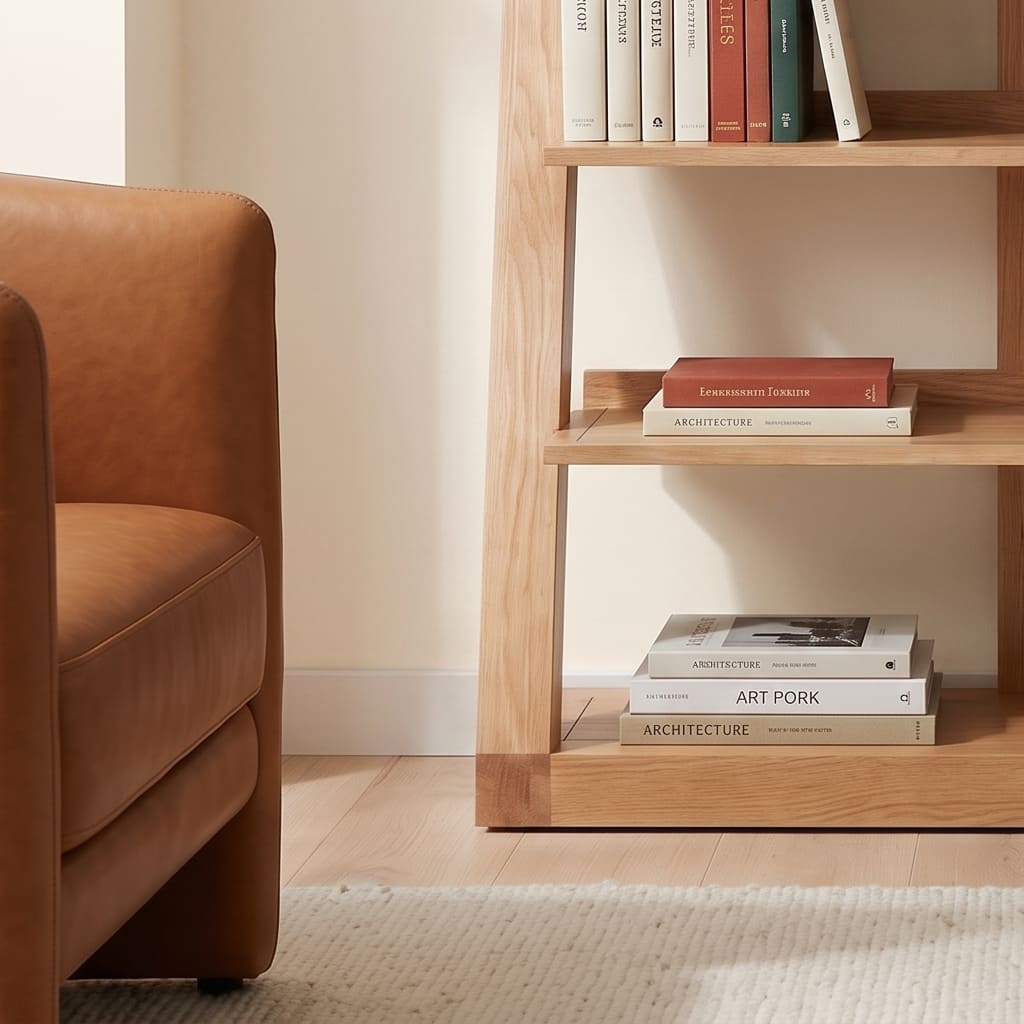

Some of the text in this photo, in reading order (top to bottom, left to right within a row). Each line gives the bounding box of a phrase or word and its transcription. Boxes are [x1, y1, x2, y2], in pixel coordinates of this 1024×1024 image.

[674, 418, 752, 427] ARCHITECTURE
[736, 691, 820, 705] ART PORK
[643, 724, 750, 736] ARCHITECTURE
